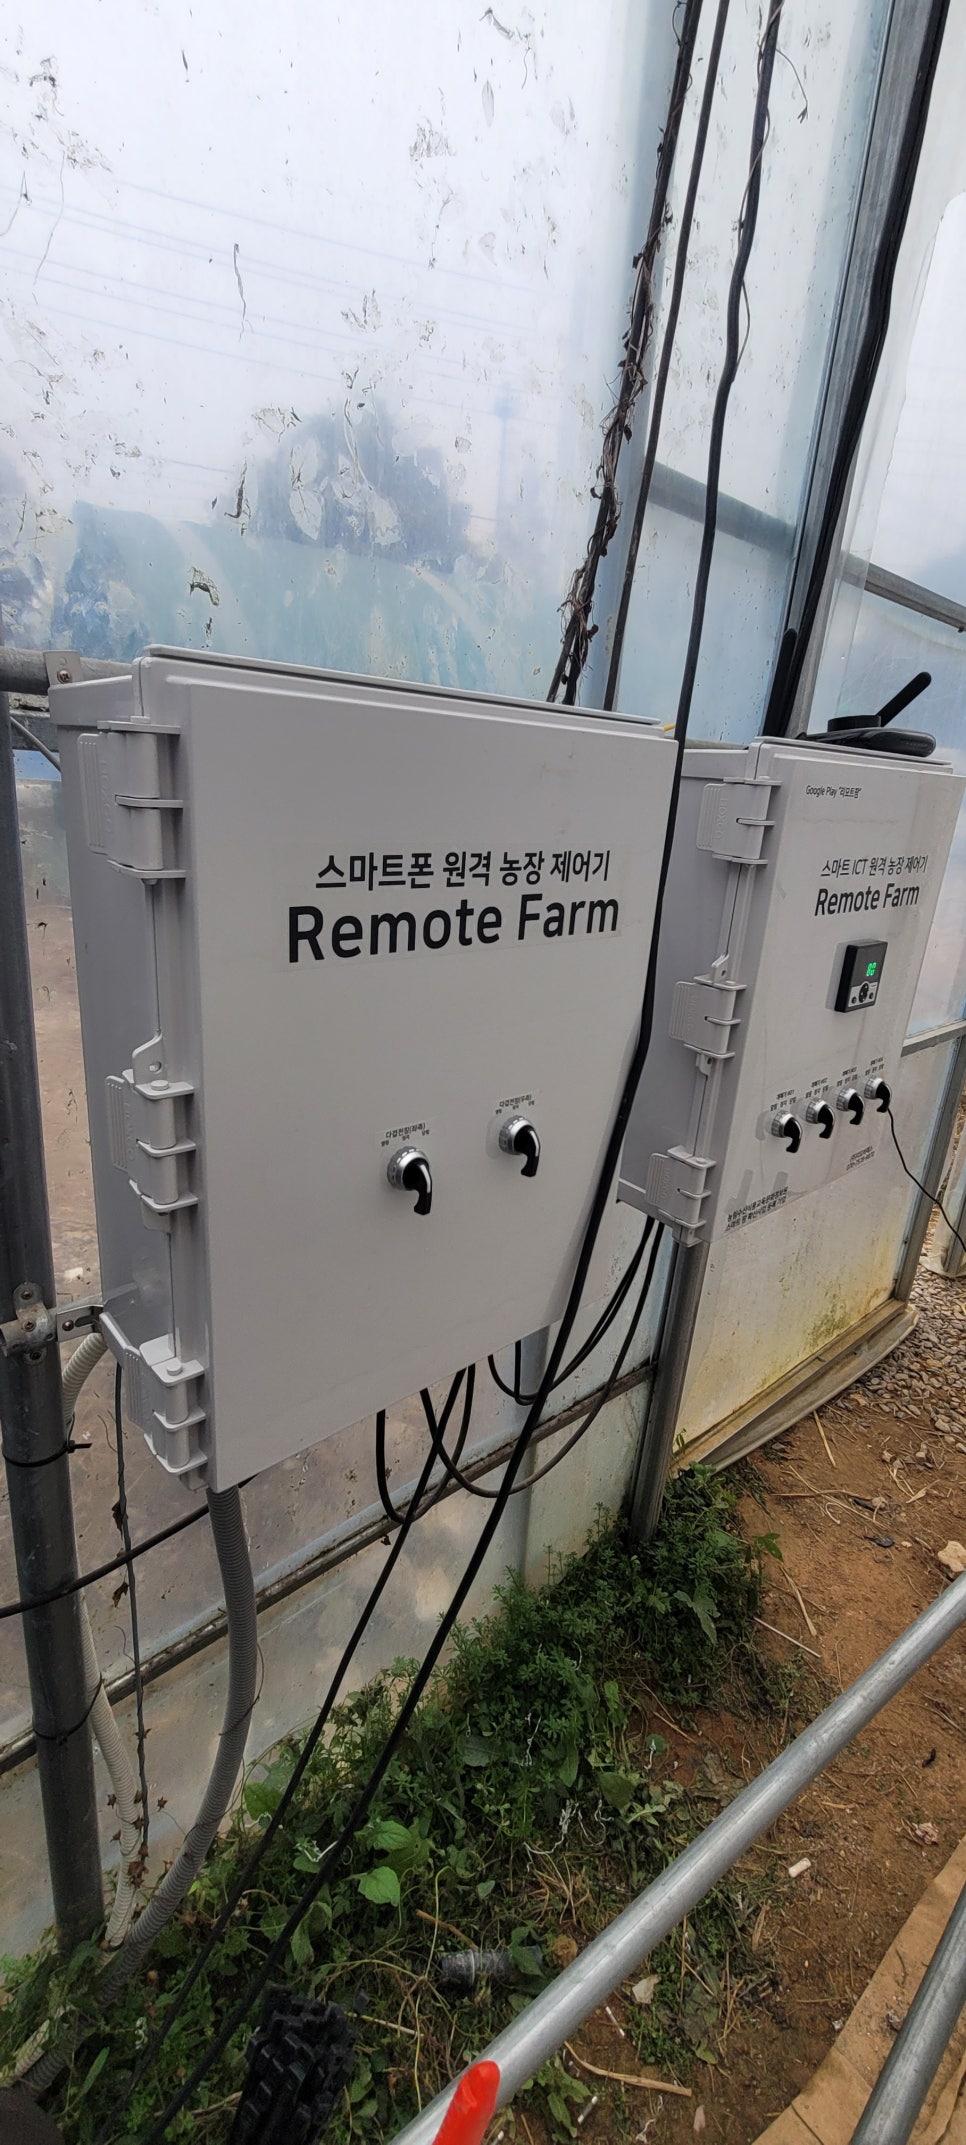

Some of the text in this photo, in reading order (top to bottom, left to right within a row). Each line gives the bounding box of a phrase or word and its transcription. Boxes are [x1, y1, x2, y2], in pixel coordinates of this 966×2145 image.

[805, 784, 826, 798] Google
[826, 786, 837, 799] Play
[315, 849, 611, 891] 스마트폰 원격 농장 제어기
[820, 854, 929, 879] 스마트 ICT 원격 농장 제어기
[814, 882, 920, 917] Remote Farm
[288, 892, 620, 964] Remote Farm
